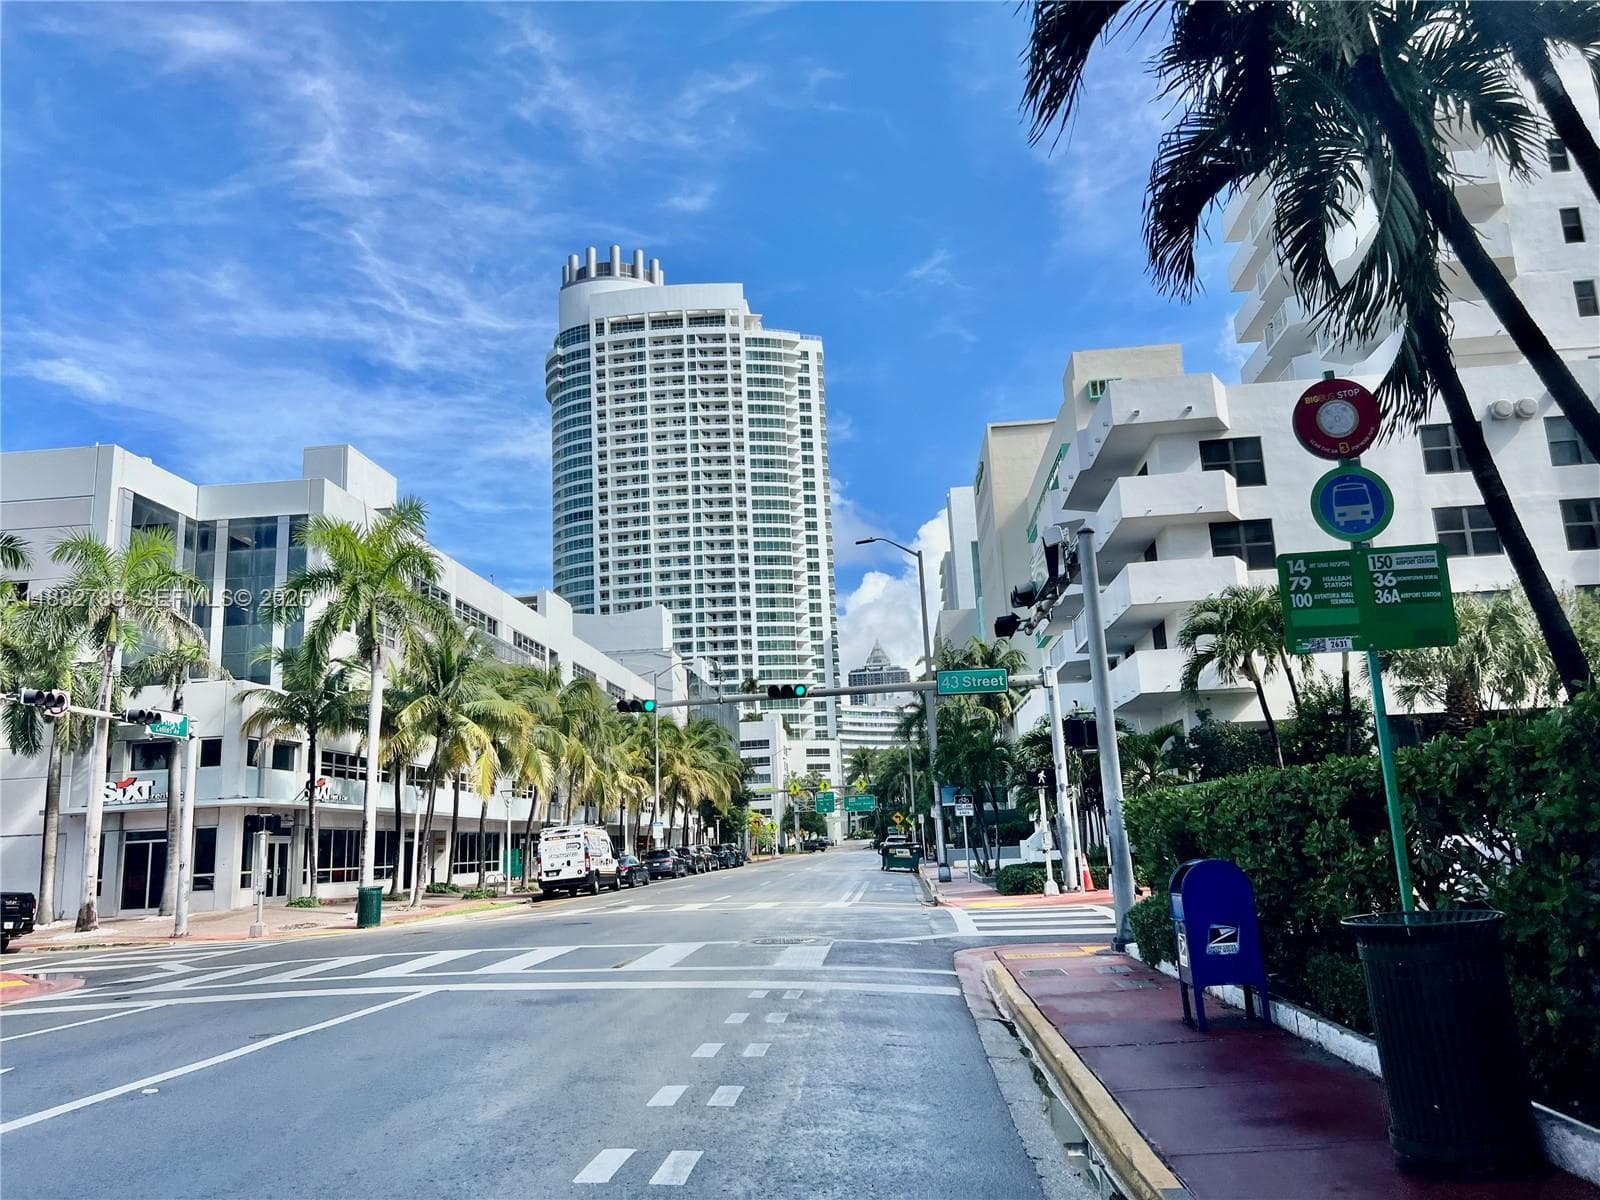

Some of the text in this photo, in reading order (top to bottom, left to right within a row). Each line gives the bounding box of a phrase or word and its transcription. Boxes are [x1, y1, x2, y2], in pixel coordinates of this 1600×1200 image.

[1336, 387, 1361, 400] STOP
[1286, 559, 1307, 574] 14
[1370, 555, 1393, 570] 150
[1289, 576, 1312, 591] 79
[1324, 581, 1353, 589] STATION
[1373, 572, 1398, 588] 36
[1290, 593, 1313, 608] 100
[1374, 588, 1402, 604] 36A
[1330, 640, 1348, 649] 2631
[941, 675, 1005, 689] 43 Street
[104, 777, 154, 802] SIXT
